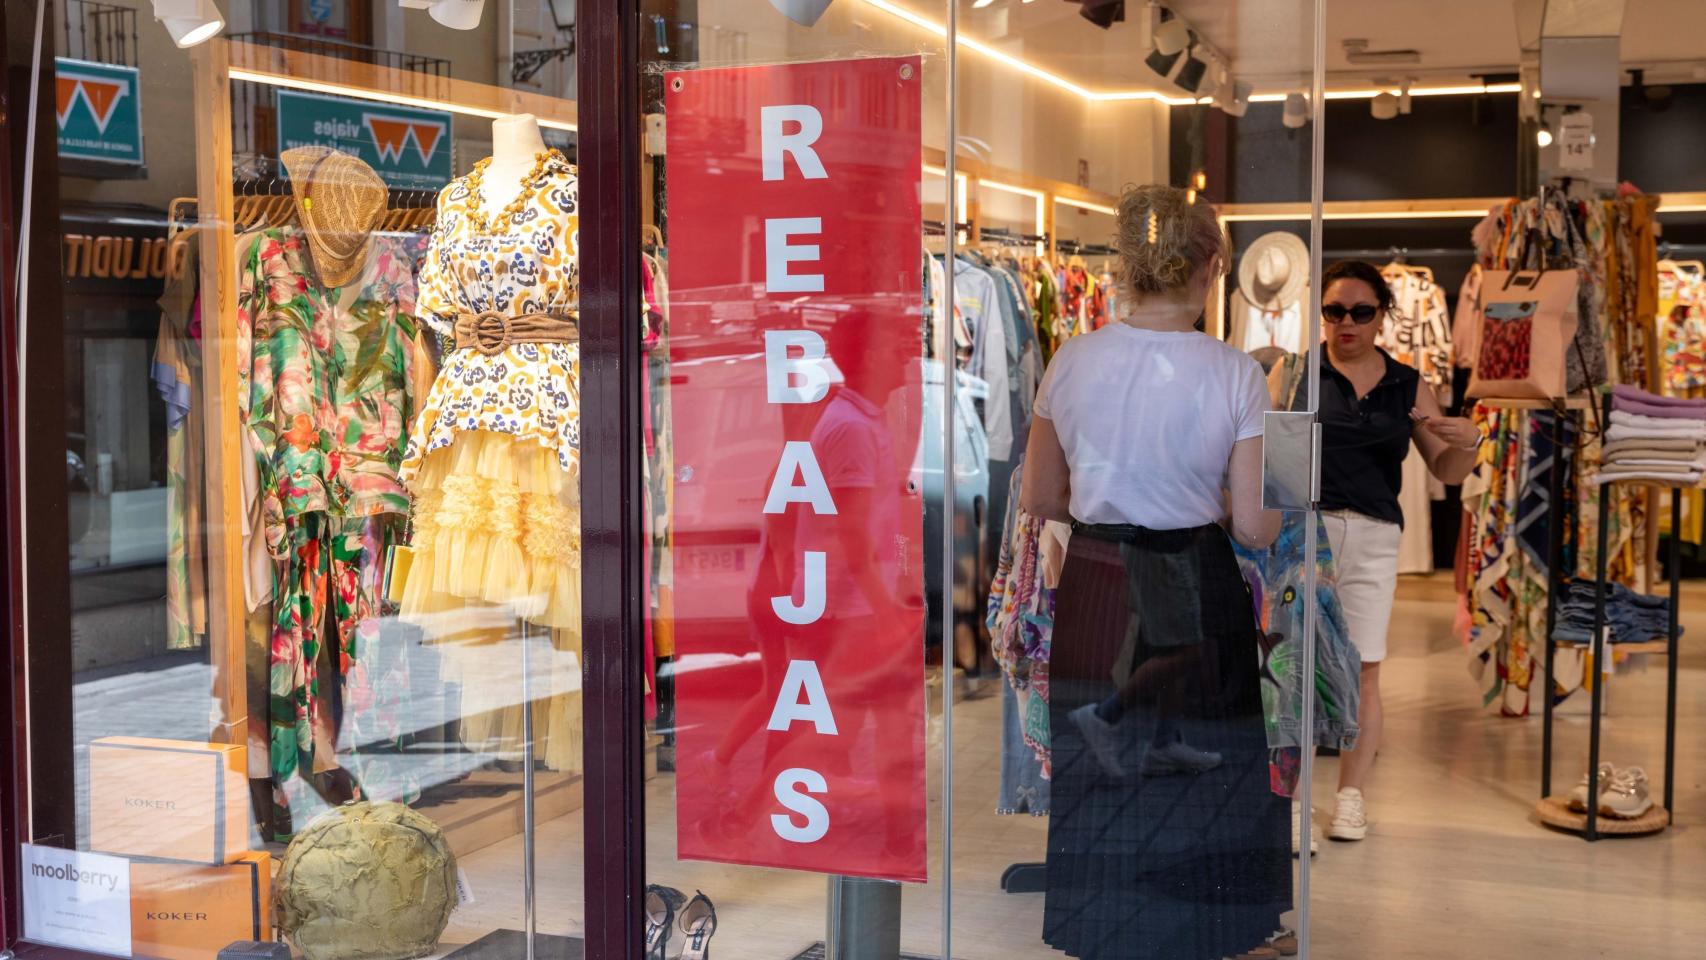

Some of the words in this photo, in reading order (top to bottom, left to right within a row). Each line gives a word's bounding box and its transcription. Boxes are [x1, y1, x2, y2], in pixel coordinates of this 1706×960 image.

[761, 104, 838, 843] REBAJAS
[125, 798, 176, 811] KOKER
[31, 863, 118, 892] moolberry
[146, 911, 208, 921] KOKER
